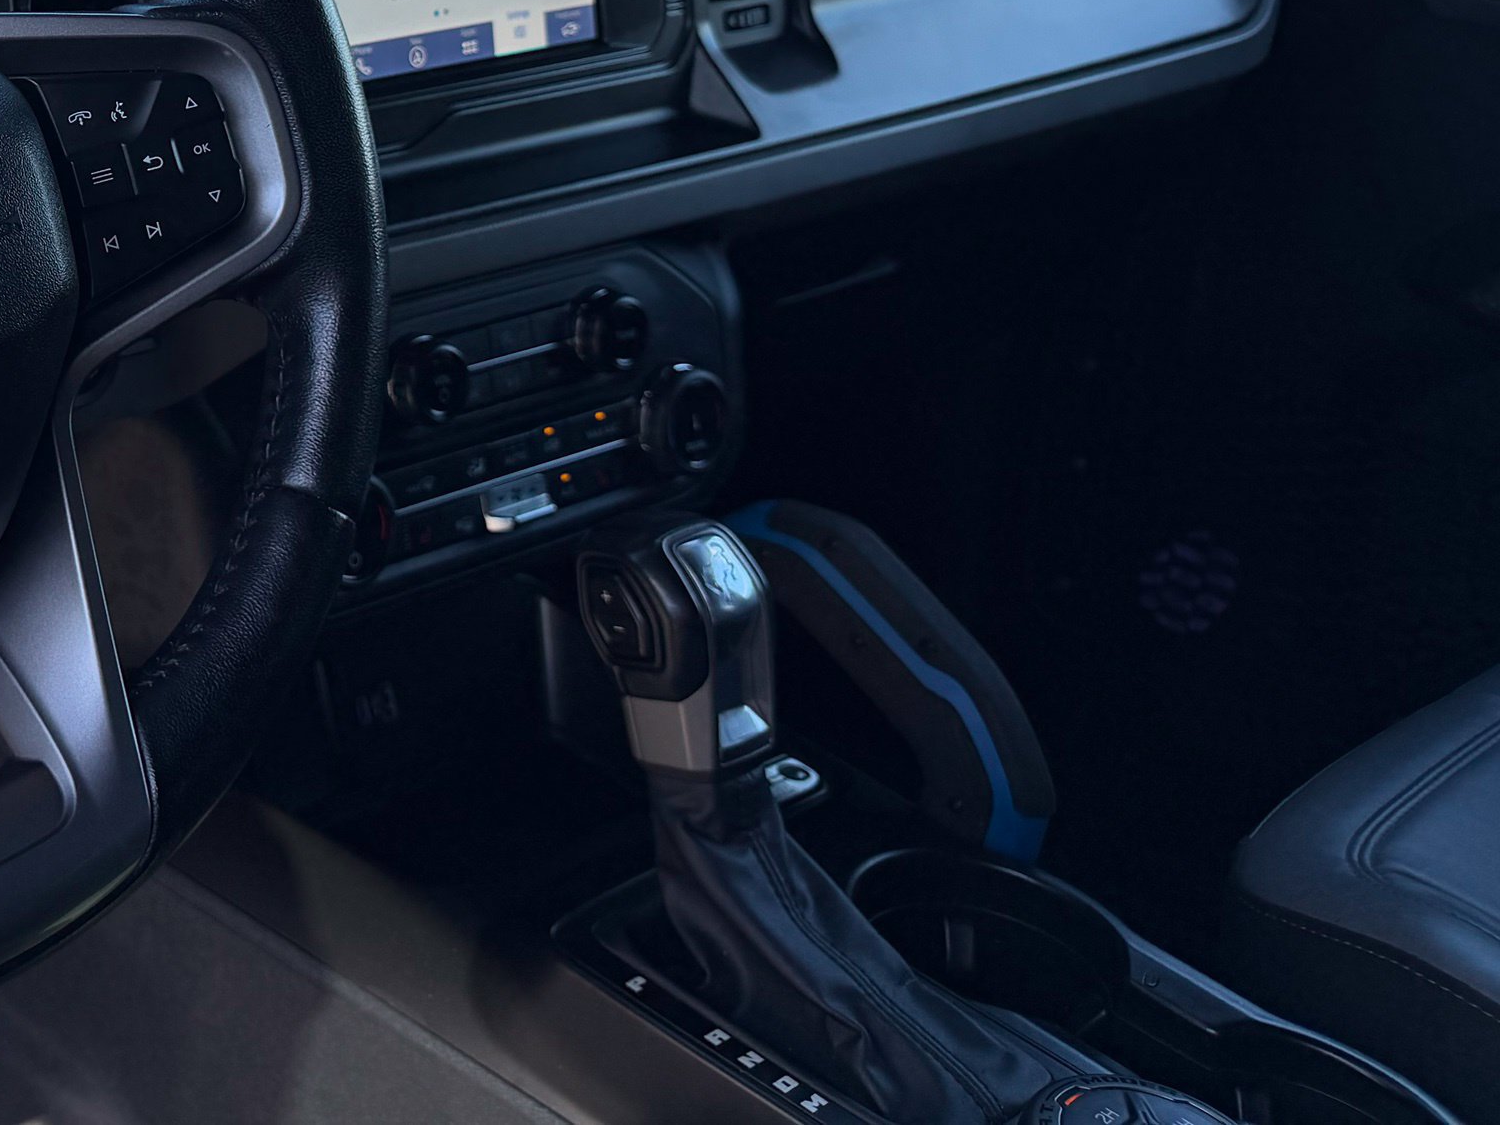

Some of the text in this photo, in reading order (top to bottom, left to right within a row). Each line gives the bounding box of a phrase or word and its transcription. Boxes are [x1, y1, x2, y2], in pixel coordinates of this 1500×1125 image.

[193, 143, 211, 155] OK
[625, 976, 829, 1114] P R N D M
[1095, 1107, 1121, 1125] 2H
